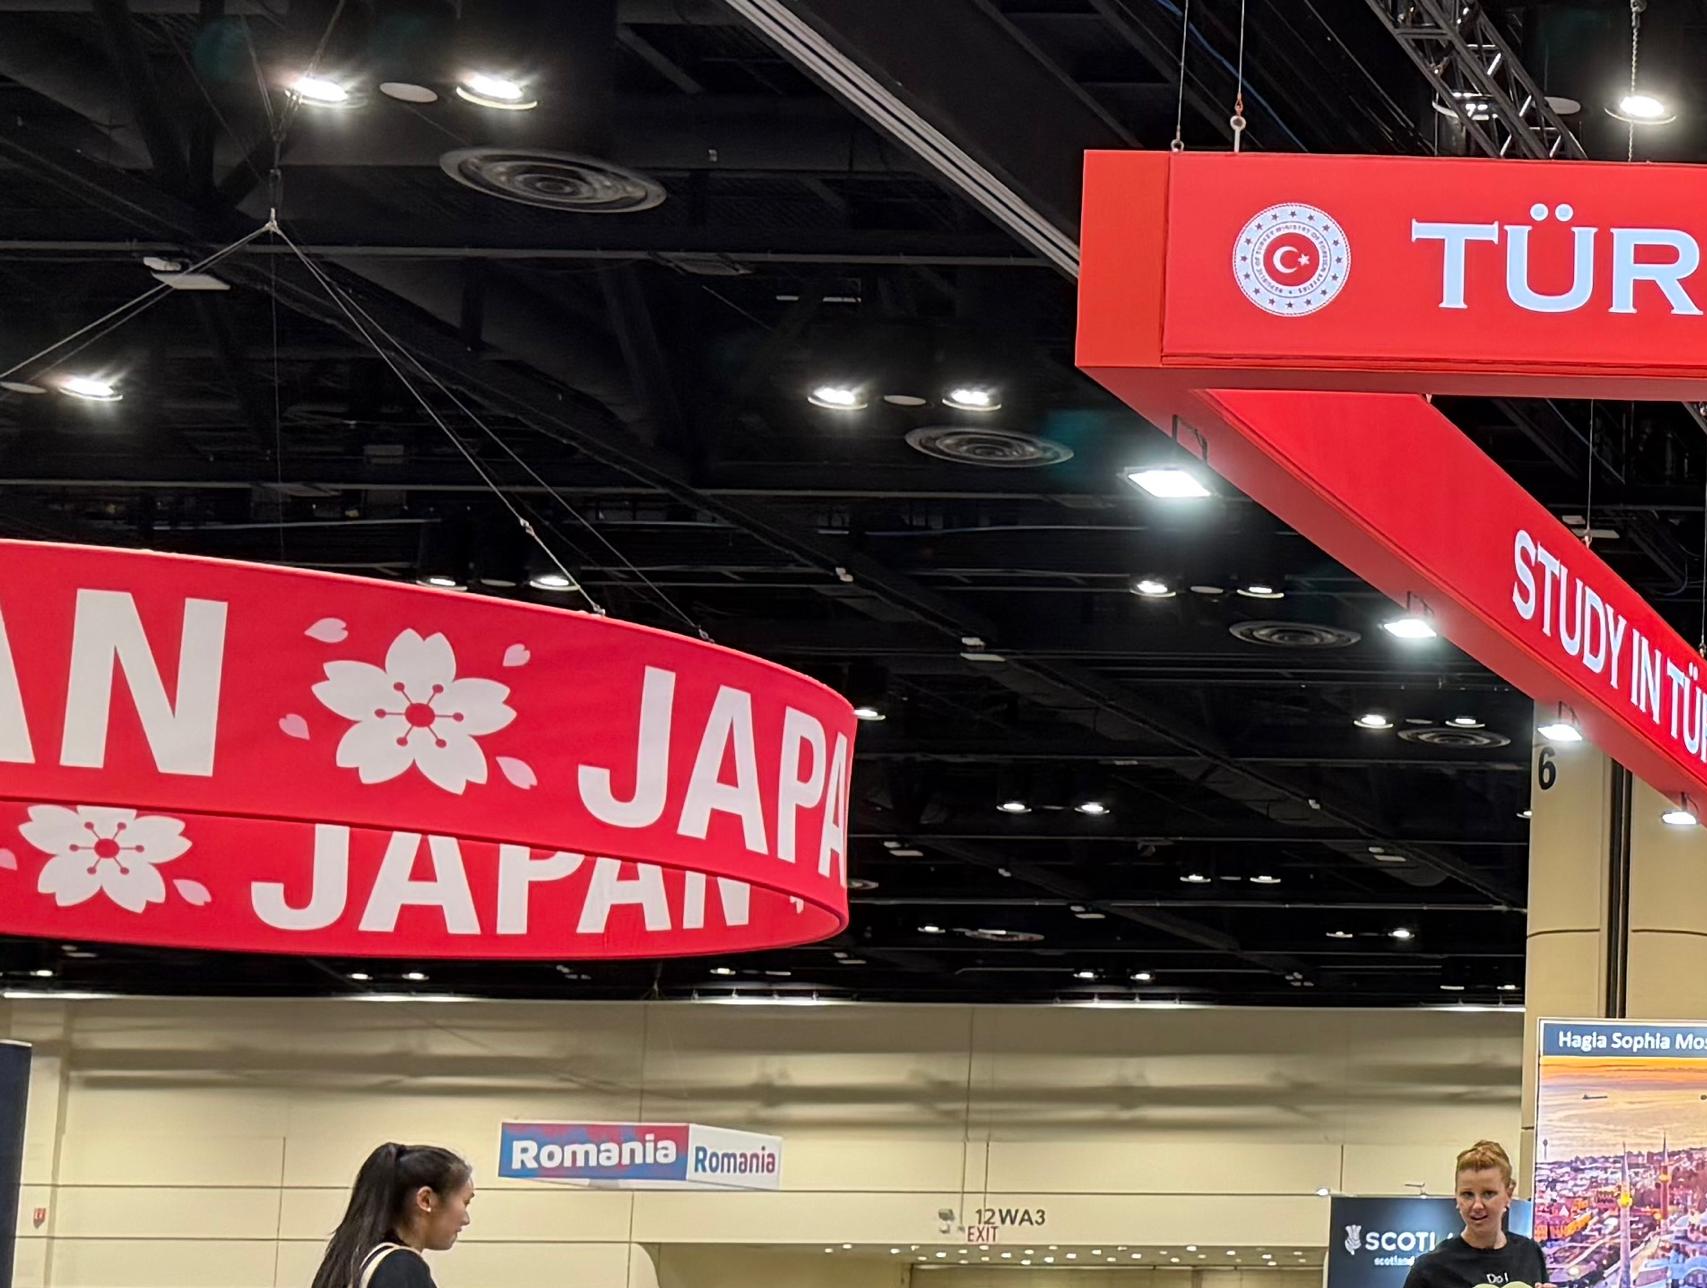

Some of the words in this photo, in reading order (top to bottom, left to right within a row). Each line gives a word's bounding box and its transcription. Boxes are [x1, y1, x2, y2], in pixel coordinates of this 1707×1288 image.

[1512, 530, 1627, 689] STUDY
[1630, 628, 1662, 724] IN
[1539, 746, 1556, 790] 6
[1559, 1031, 1607, 1051] Hagia
[1611, 1032, 1670, 1052] Sophia
[511, 1133, 677, 1170] Romania
[694, 1145, 776, 1175] Romania
[967, 1226, 999, 1242] EXIT
